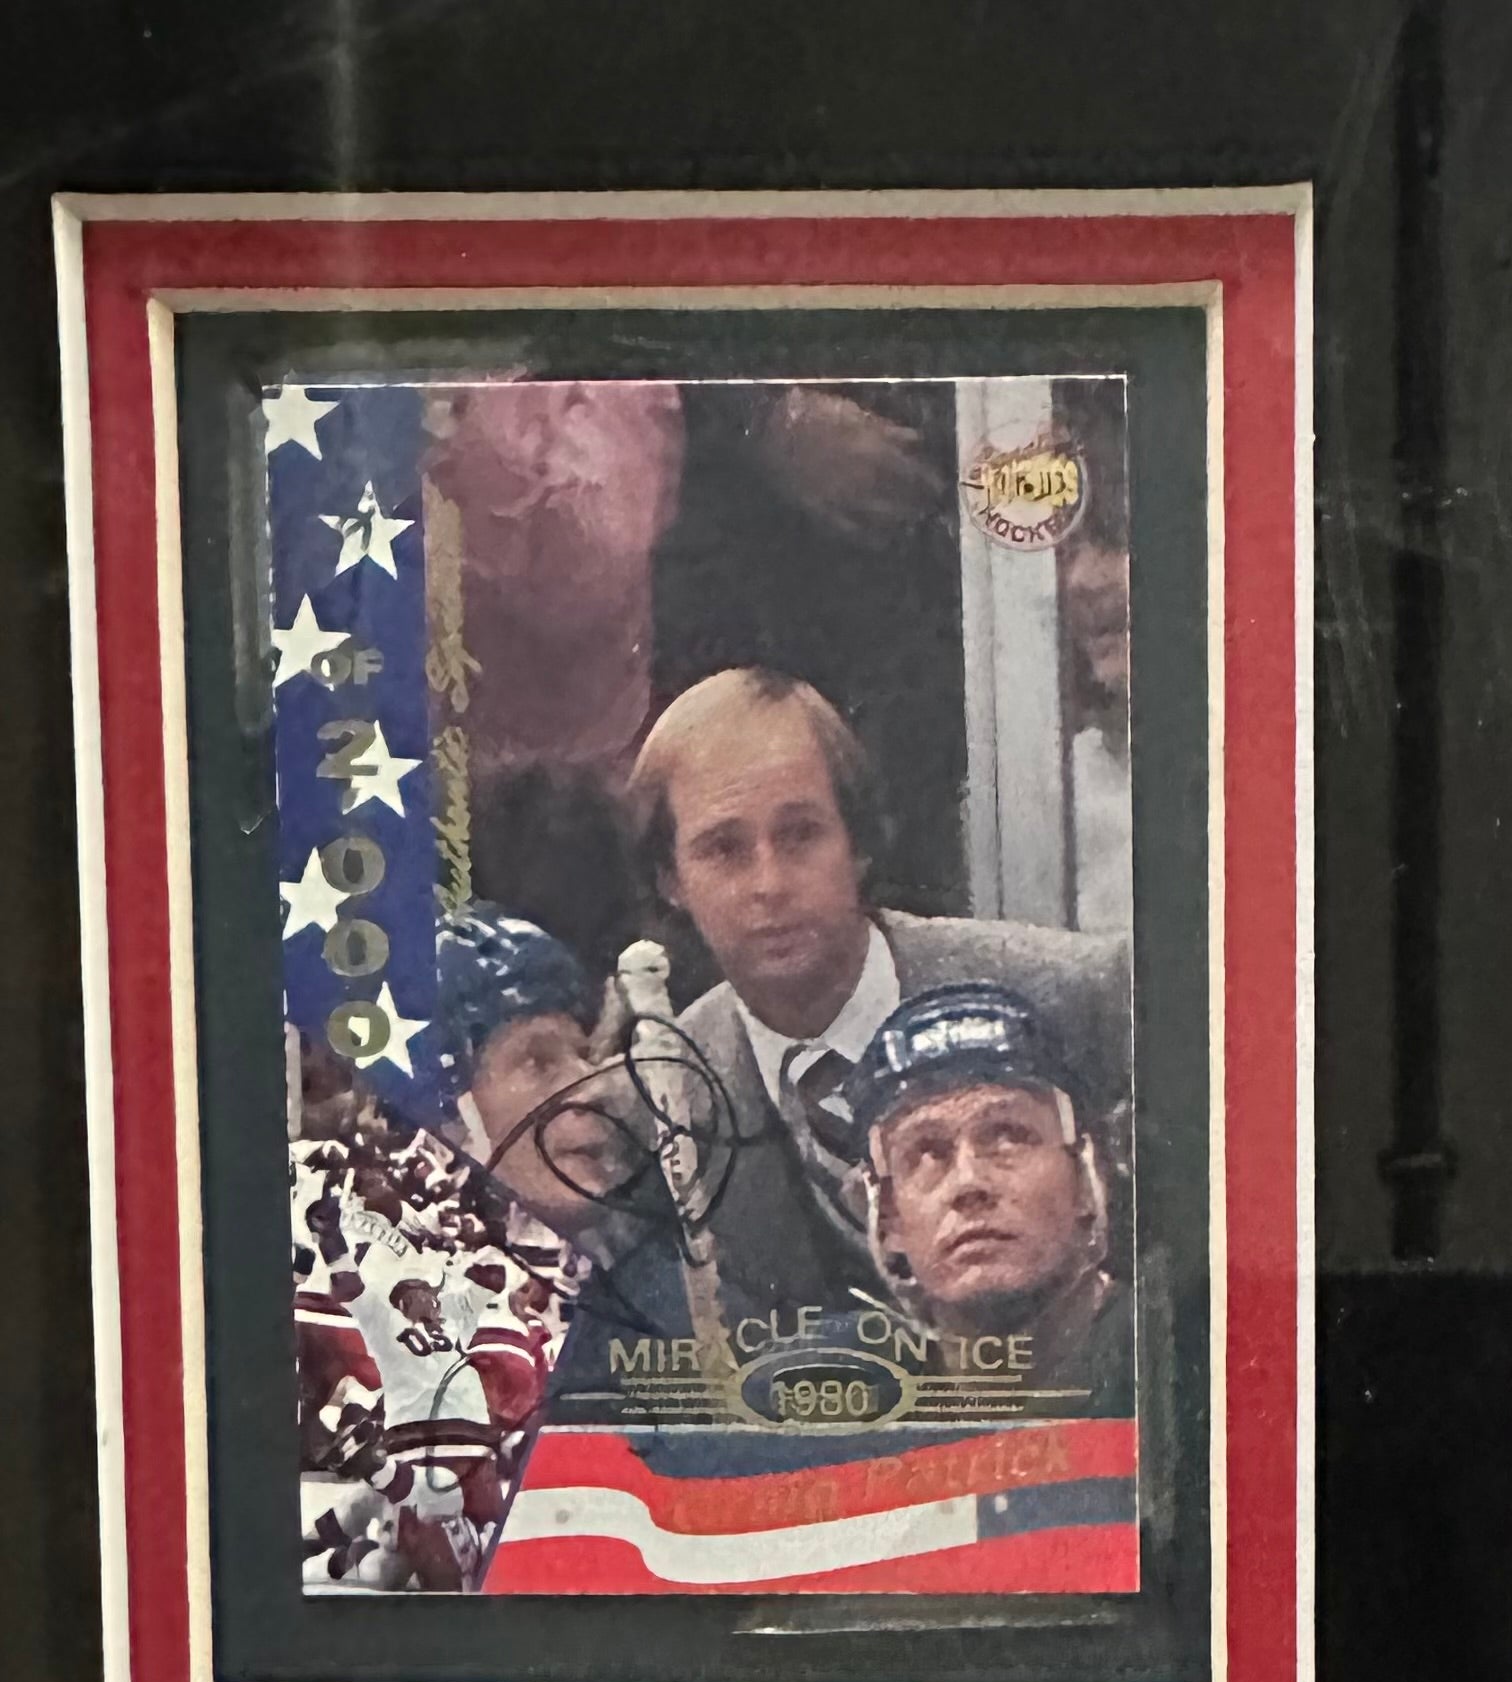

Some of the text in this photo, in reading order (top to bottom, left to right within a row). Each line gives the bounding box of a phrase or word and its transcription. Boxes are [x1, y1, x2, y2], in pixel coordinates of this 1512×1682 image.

[857, 1309, 928, 1362] ON
[958, 1334, 1033, 1371] ICE
[772, 1380, 870, 1416] 1980
